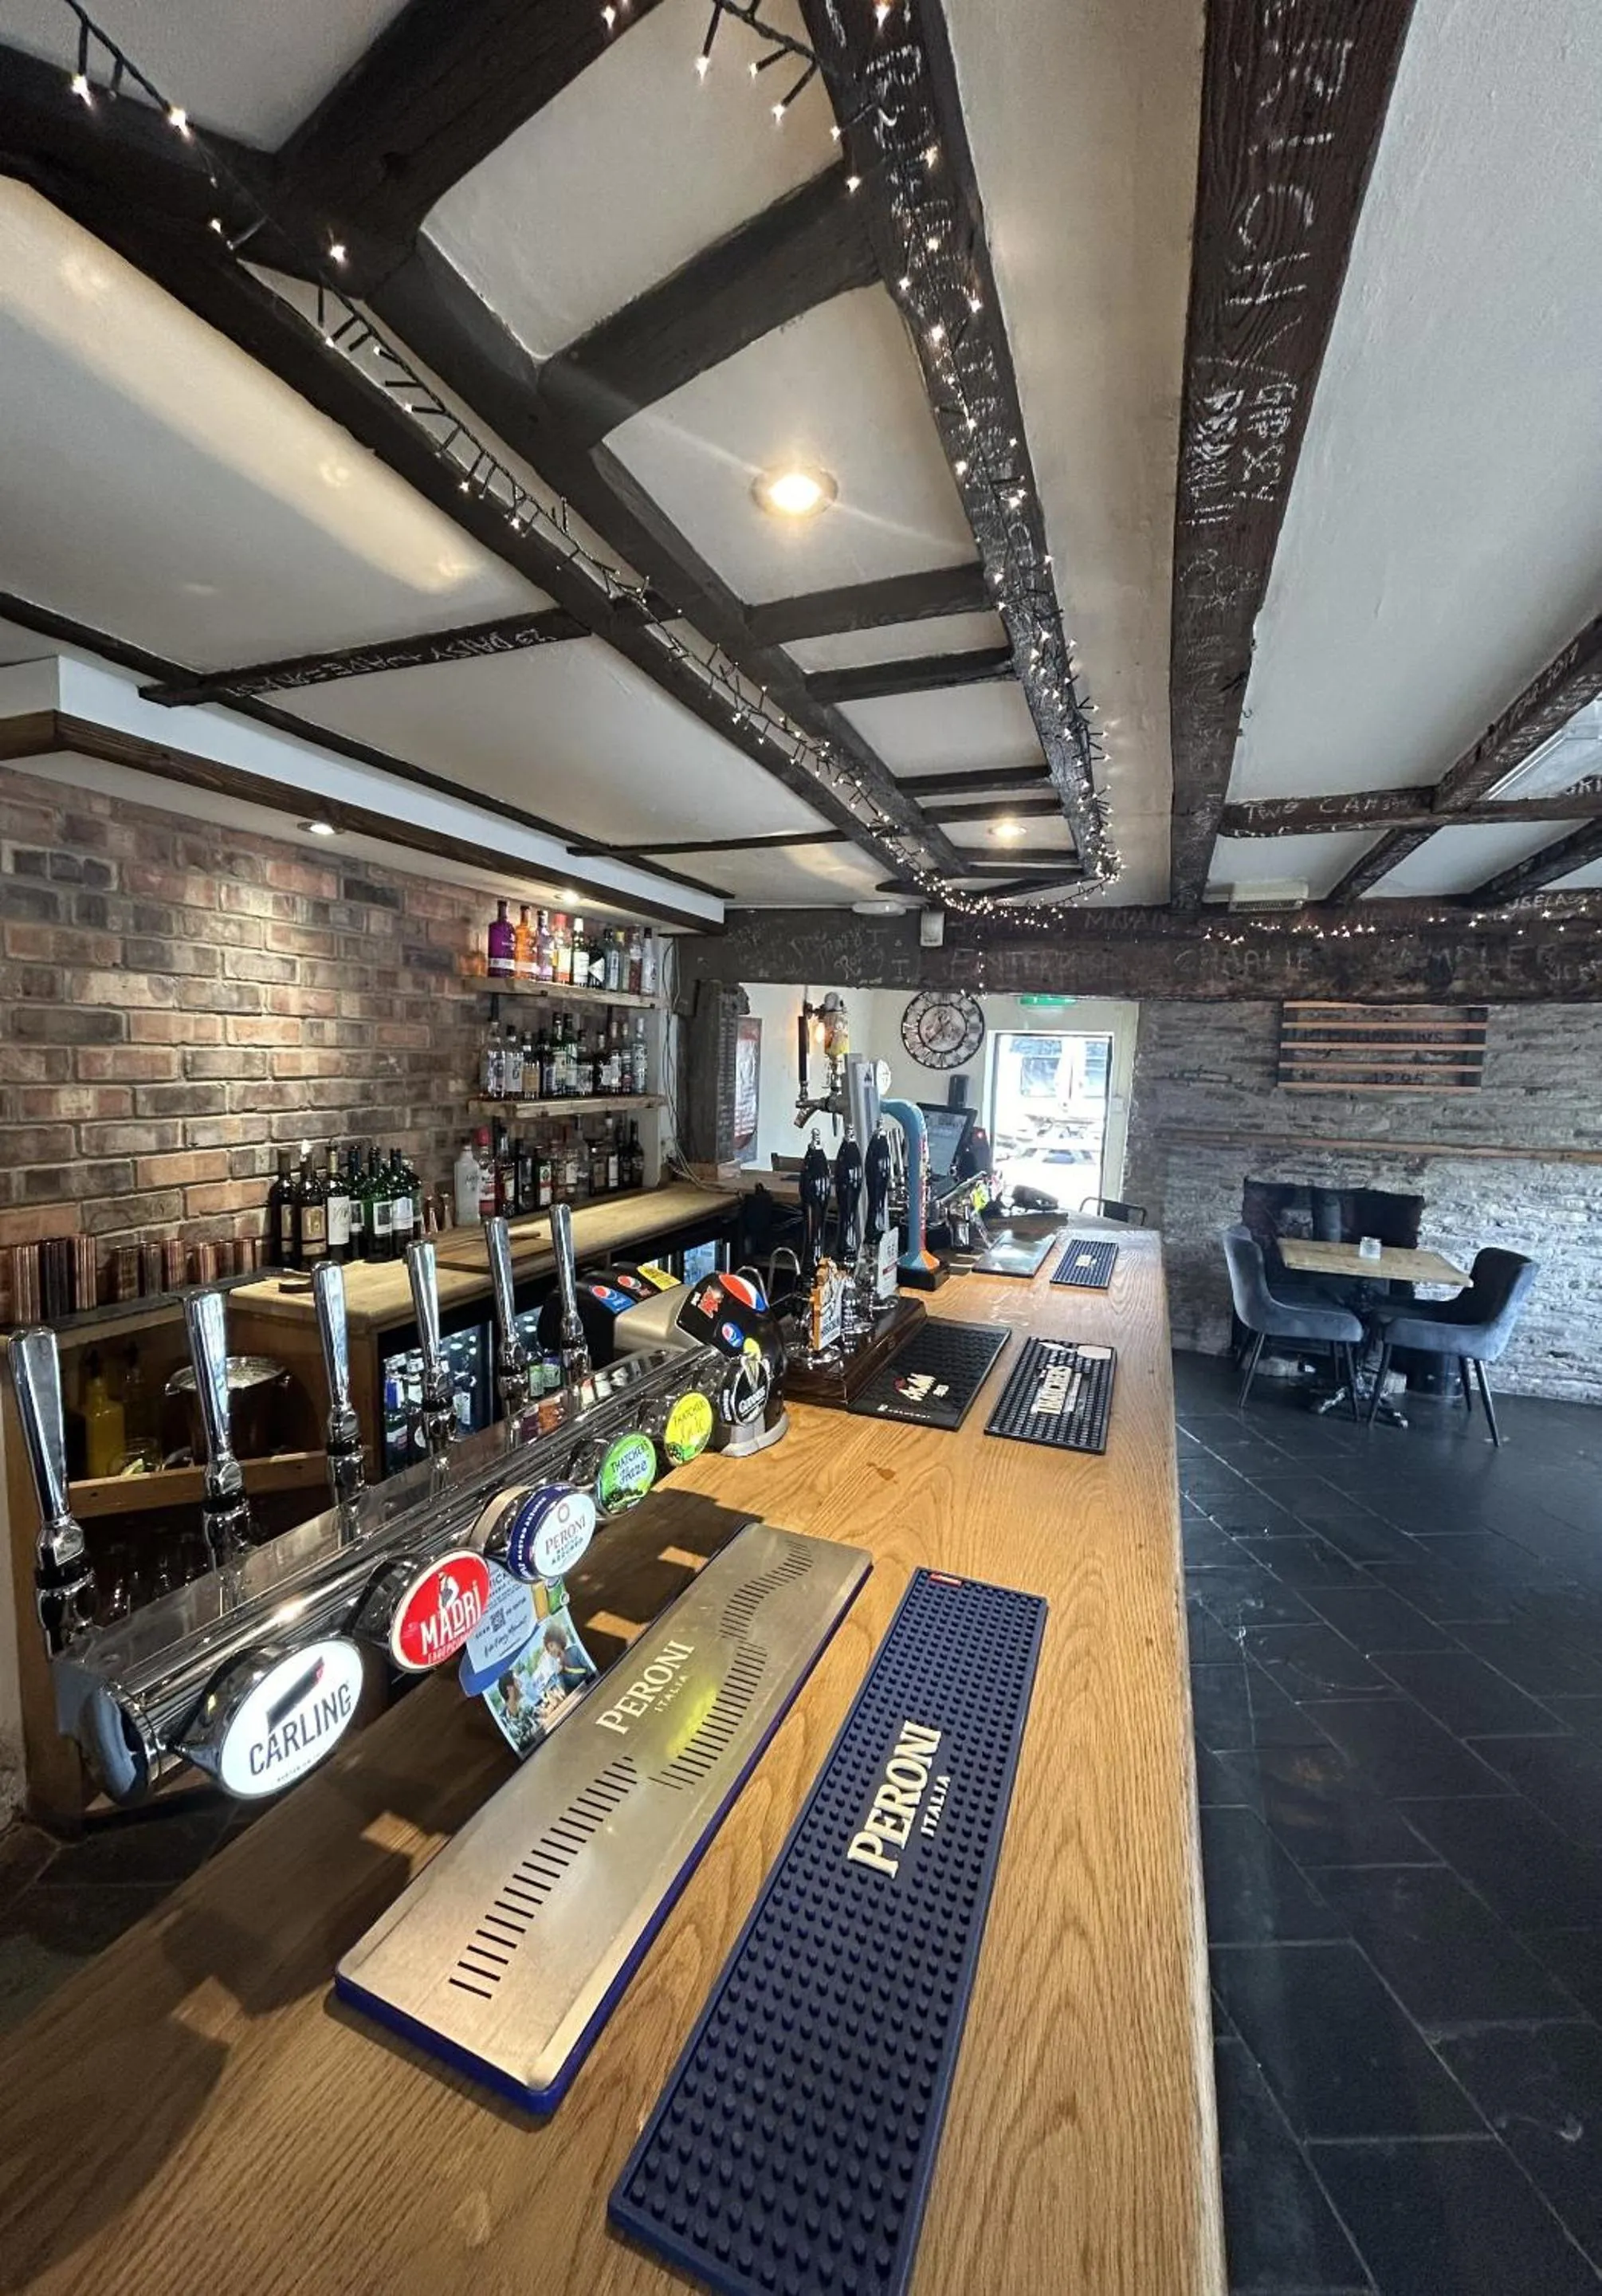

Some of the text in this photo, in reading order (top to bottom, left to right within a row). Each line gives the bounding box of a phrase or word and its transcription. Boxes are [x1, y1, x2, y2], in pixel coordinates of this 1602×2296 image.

[545, 1513, 587, 1555] PERONI
[595, 1640, 696, 1735] PERONI
[654, 1675, 689, 1712] ITALIA
[249, 1683, 351, 1776] CARLING
[846, 1719, 943, 1879] PERONI
[920, 1774, 952, 1837] ITALIA
